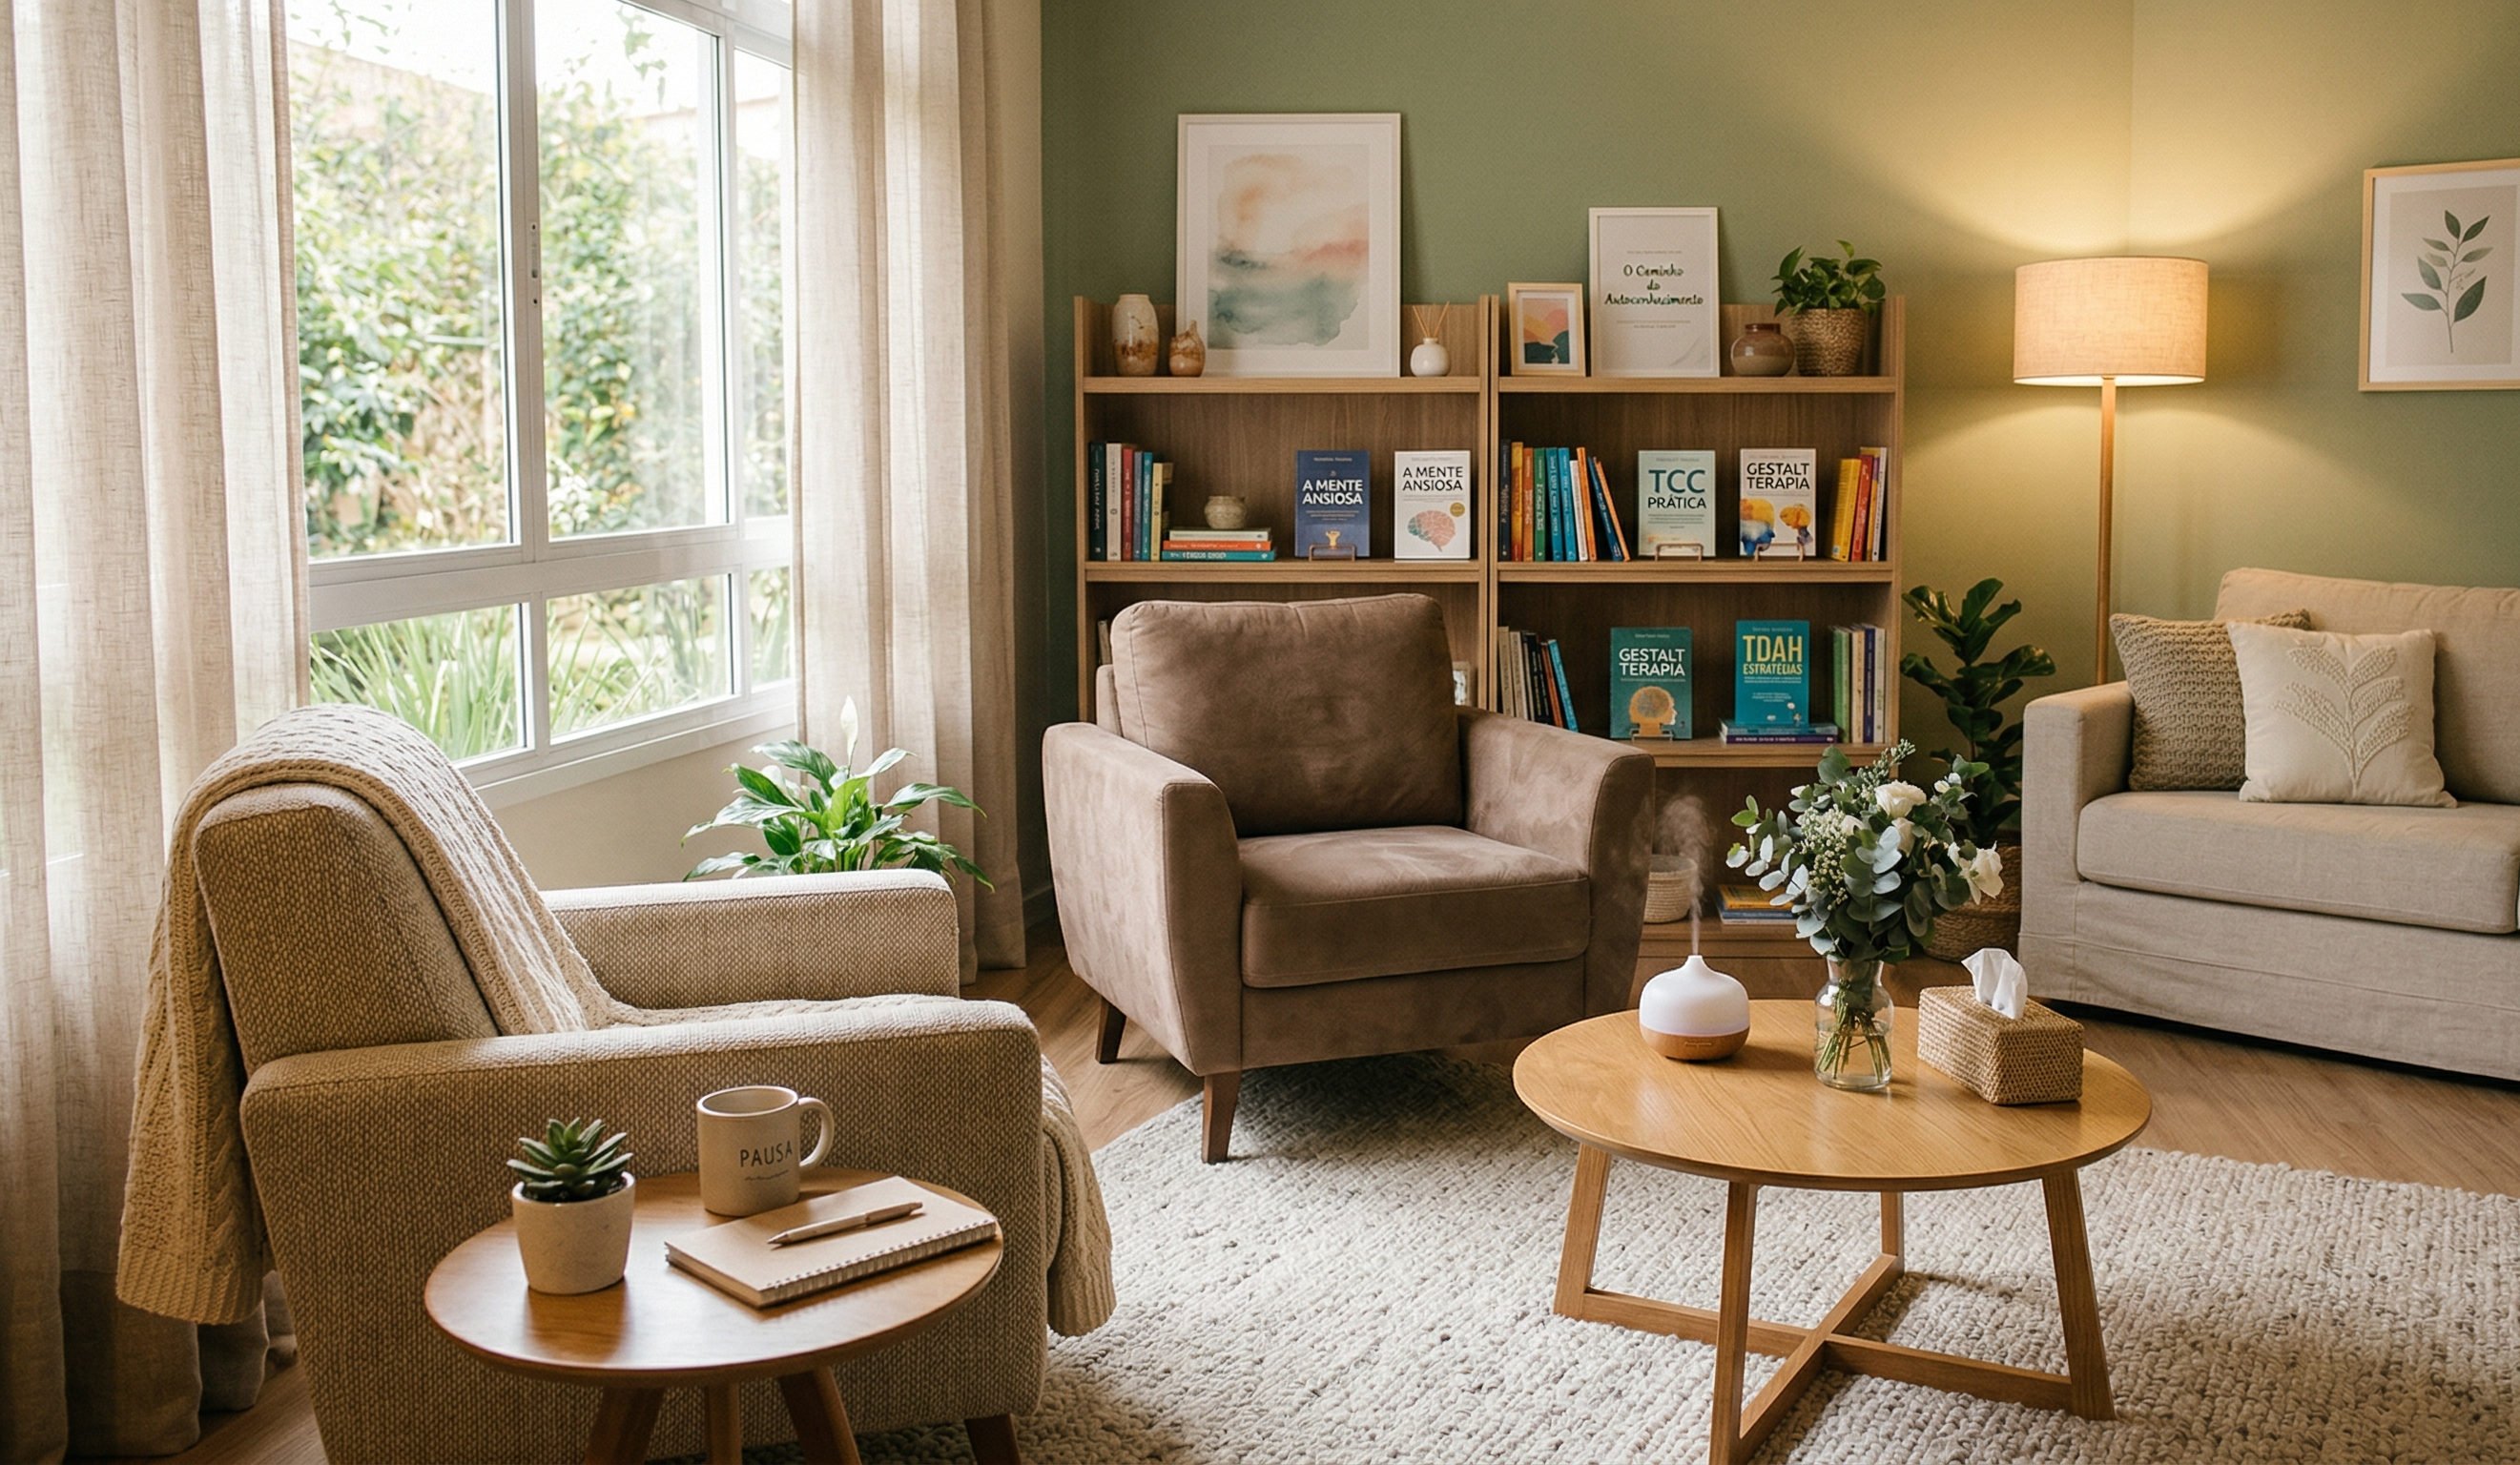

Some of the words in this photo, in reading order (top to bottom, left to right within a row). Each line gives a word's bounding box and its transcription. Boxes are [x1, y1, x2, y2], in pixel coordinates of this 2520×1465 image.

[1623, 264, 1633, 277] O
[1402, 467, 1412, 478] A
[1415, 466, 1463, 478] MENTE
[1746, 463, 1809, 475] GESTALT
[1302, 480, 1313, 491] A
[1315, 480, 1363, 491] MENTE
[1402, 479, 1463, 491] ANSIOSA
[1648, 469, 1705, 493] TCC
[1746, 477, 1810, 489] TERAPIA
[1302, 492, 1363, 505] ANSIOSA
[1647, 494, 1706, 508] PRÁTICA
[1619, 648, 1685, 662] GESTALT
[1743, 635, 1803, 662] TDAH
[1619, 663, 1685, 676] TERAPIA
[740, 1140, 793, 1167] PAUSA
